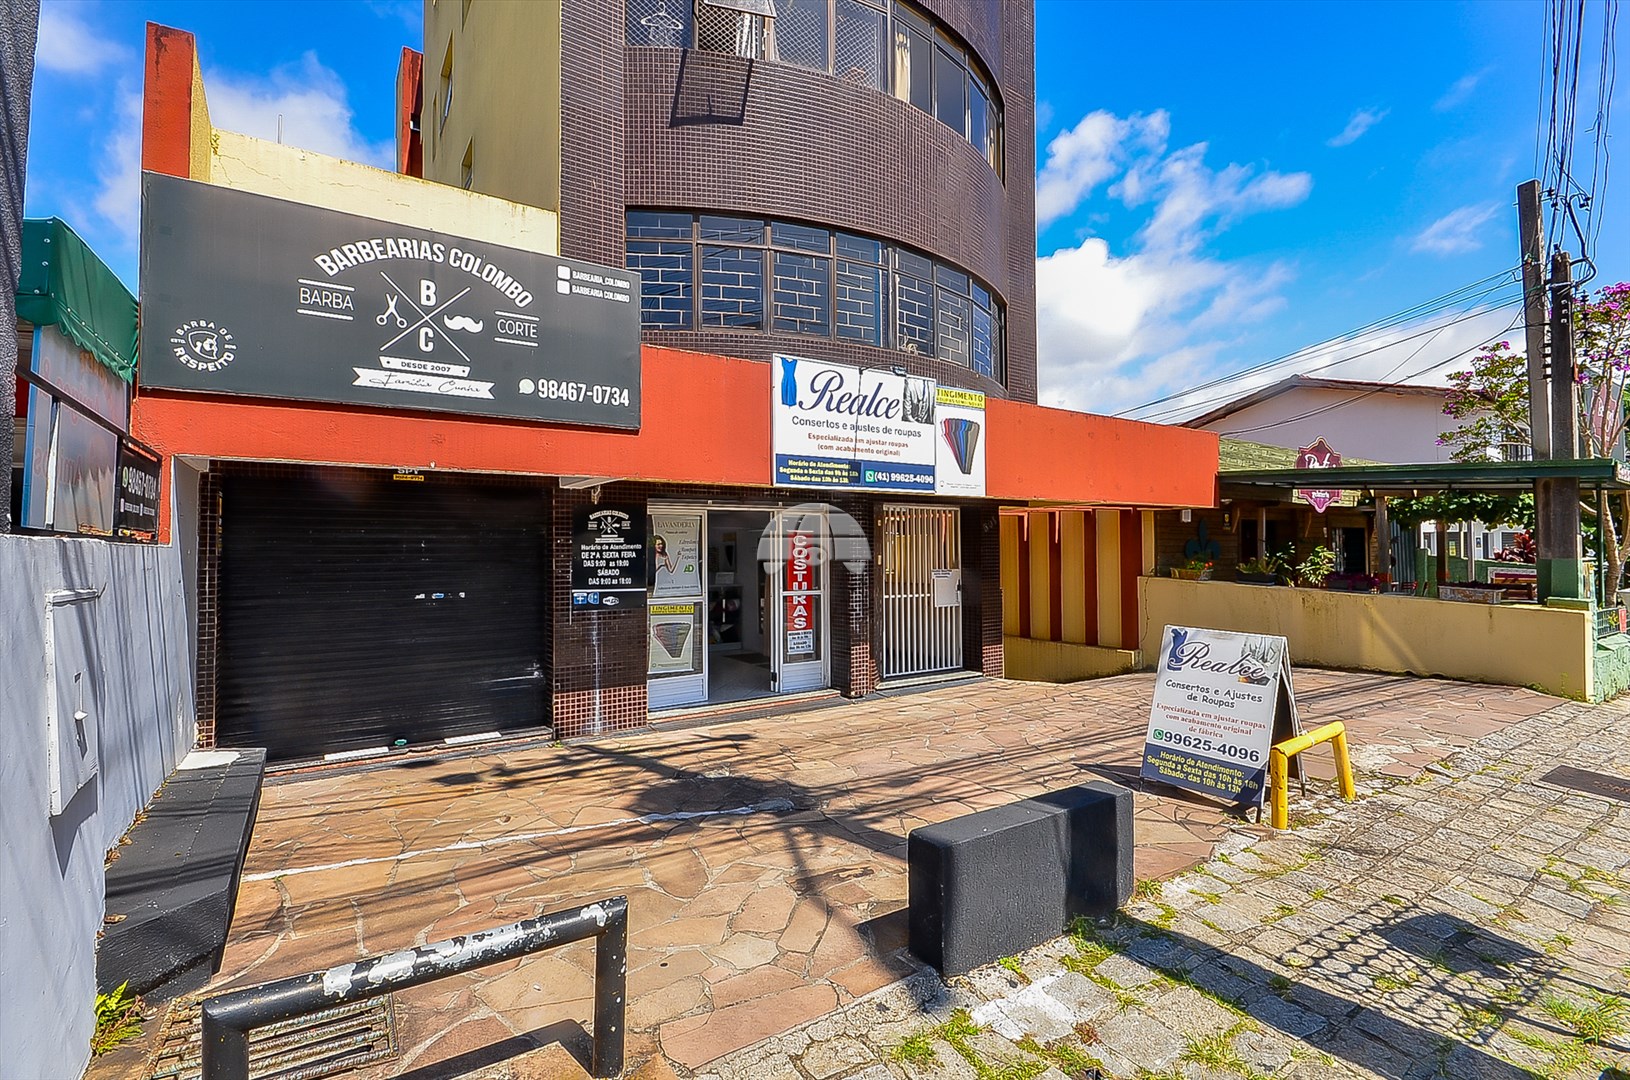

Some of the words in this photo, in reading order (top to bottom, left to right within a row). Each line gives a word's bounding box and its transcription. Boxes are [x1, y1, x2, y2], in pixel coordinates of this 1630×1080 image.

[313, 237, 446, 277] BARBEARIAS
[448, 248, 534, 308] COLOMBO
[300, 287, 354, 311] BARBA
[420, 279, 437, 306] B
[571, 284, 603, 298] BARBEARIA
[603, 290, 630, 303] COLOMBO
[175, 320, 215, 336] BARBA
[219, 328, 233, 341] DE
[419, 326, 434, 352] C
[497, 319, 538, 338] CORTE
[173, 347, 235, 372] RESPEITO
[401, 361, 428, 370] DESDE
[430, 365, 451, 373] 2007
[538, 378, 630, 407] 98467-0734
[798, 369, 900, 419] Realce
[937, 389, 983, 402] TINGIMENTO
[791, 415, 840, 429] Consertos
[842, 422, 848, 430] e
[849, 423, 880, 434] ajustes
[882, 425, 892, 435] de
[894, 428, 922, 438] roupas
[807, 432, 854, 442] Especializada
[866, 437, 887, 446] ajustar
[817, 443, 834, 451] (com
[835, 445, 874, 455] acabamento
[876, 448, 901, 457] original)
[779, 466, 803, 475] Segunda
[874, 471, 890, 483] (41)
[890, 472, 934, 484] 99625-4096
[581, 551, 589, 559] DE
[602, 551, 619, 559] SEXTA
[621, 551, 636, 559] FEIRA
[588, 577, 600, 585] DAS
[597, 568, 620, 576] SÁBADO
[793, 535, 807, 629] COSTURAS
[1169, 641, 1267, 679] Realce
[1165, 679, 1210, 694] Consertos
[1223, 689, 1263, 703] Ajustes
[1186, 692, 1198, 701] de
[1201, 695, 1235, 709] Roupas
[1156, 702, 1200, 716] Especializada
[1213, 713, 1239, 724] ajustar
[1240, 719, 1266, 729] roupas
[1165, 713, 1180, 721] com
[1180, 716, 1221, 729] acabamento
[1222, 724, 1252, 736] original
[1198, 727, 1223, 738] fábrica
[1164, 731, 1260, 762] 99625-4096
[1146, 755, 1176, 769] Segunda
[1182, 764, 1202, 775] Sexta
[1203, 770, 1217, 779] das
[1218, 773, 1232, 783] 10h
[1233, 777, 1243, 786] às
[1160, 751, 1185, 763] Horário
[1186, 757, 1195, 766] de
[1196, 761, 1245, 778] Atendimento:
[1158, 766, 1187, 780] Sábado:
[1187, 774, 1201, 784] das
[1202, 778, 1216, 788] 10h
[1216, 781, 1226, 790] às
[1227, 783, 1241, 794] 13h
